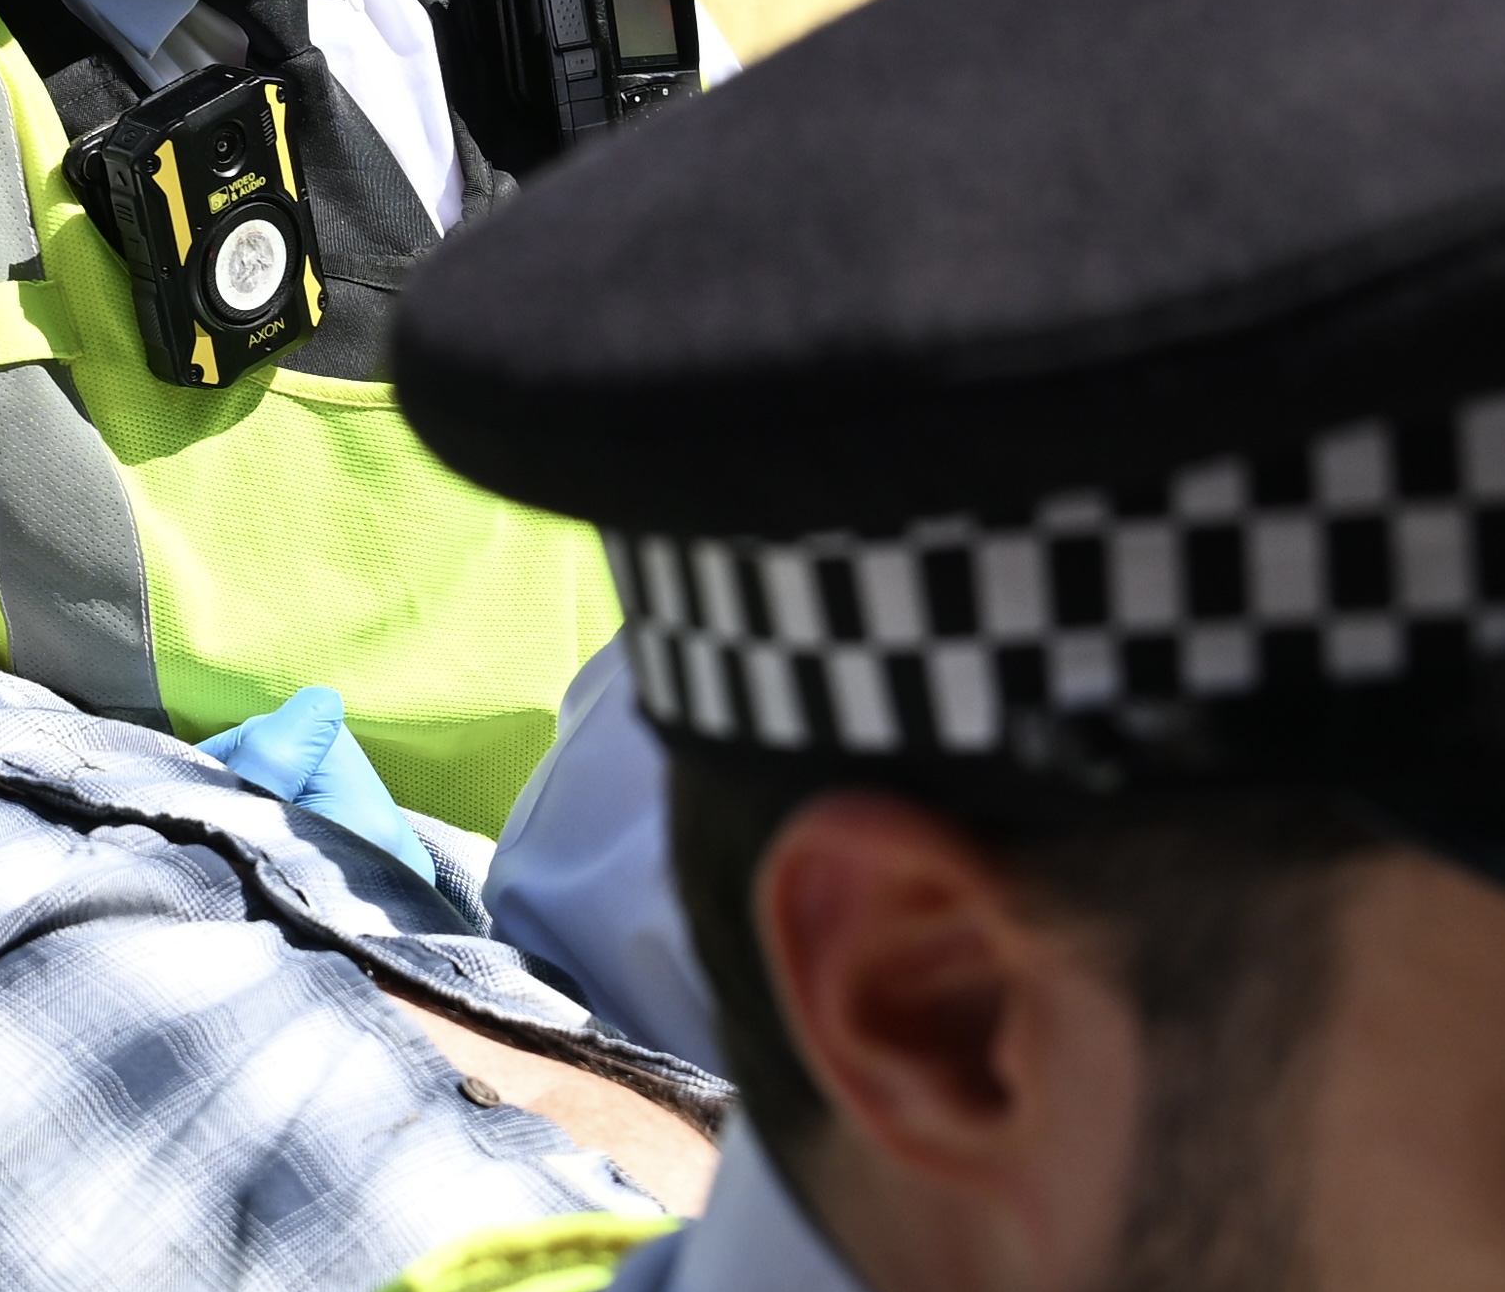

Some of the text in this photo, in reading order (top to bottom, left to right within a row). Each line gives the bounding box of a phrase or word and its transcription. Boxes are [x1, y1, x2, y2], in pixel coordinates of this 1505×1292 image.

[228, 172, 256, 192] VIDEO
[230, 176, 267, 203] & AUDIO
[248, 317, 286, 349] AXON
